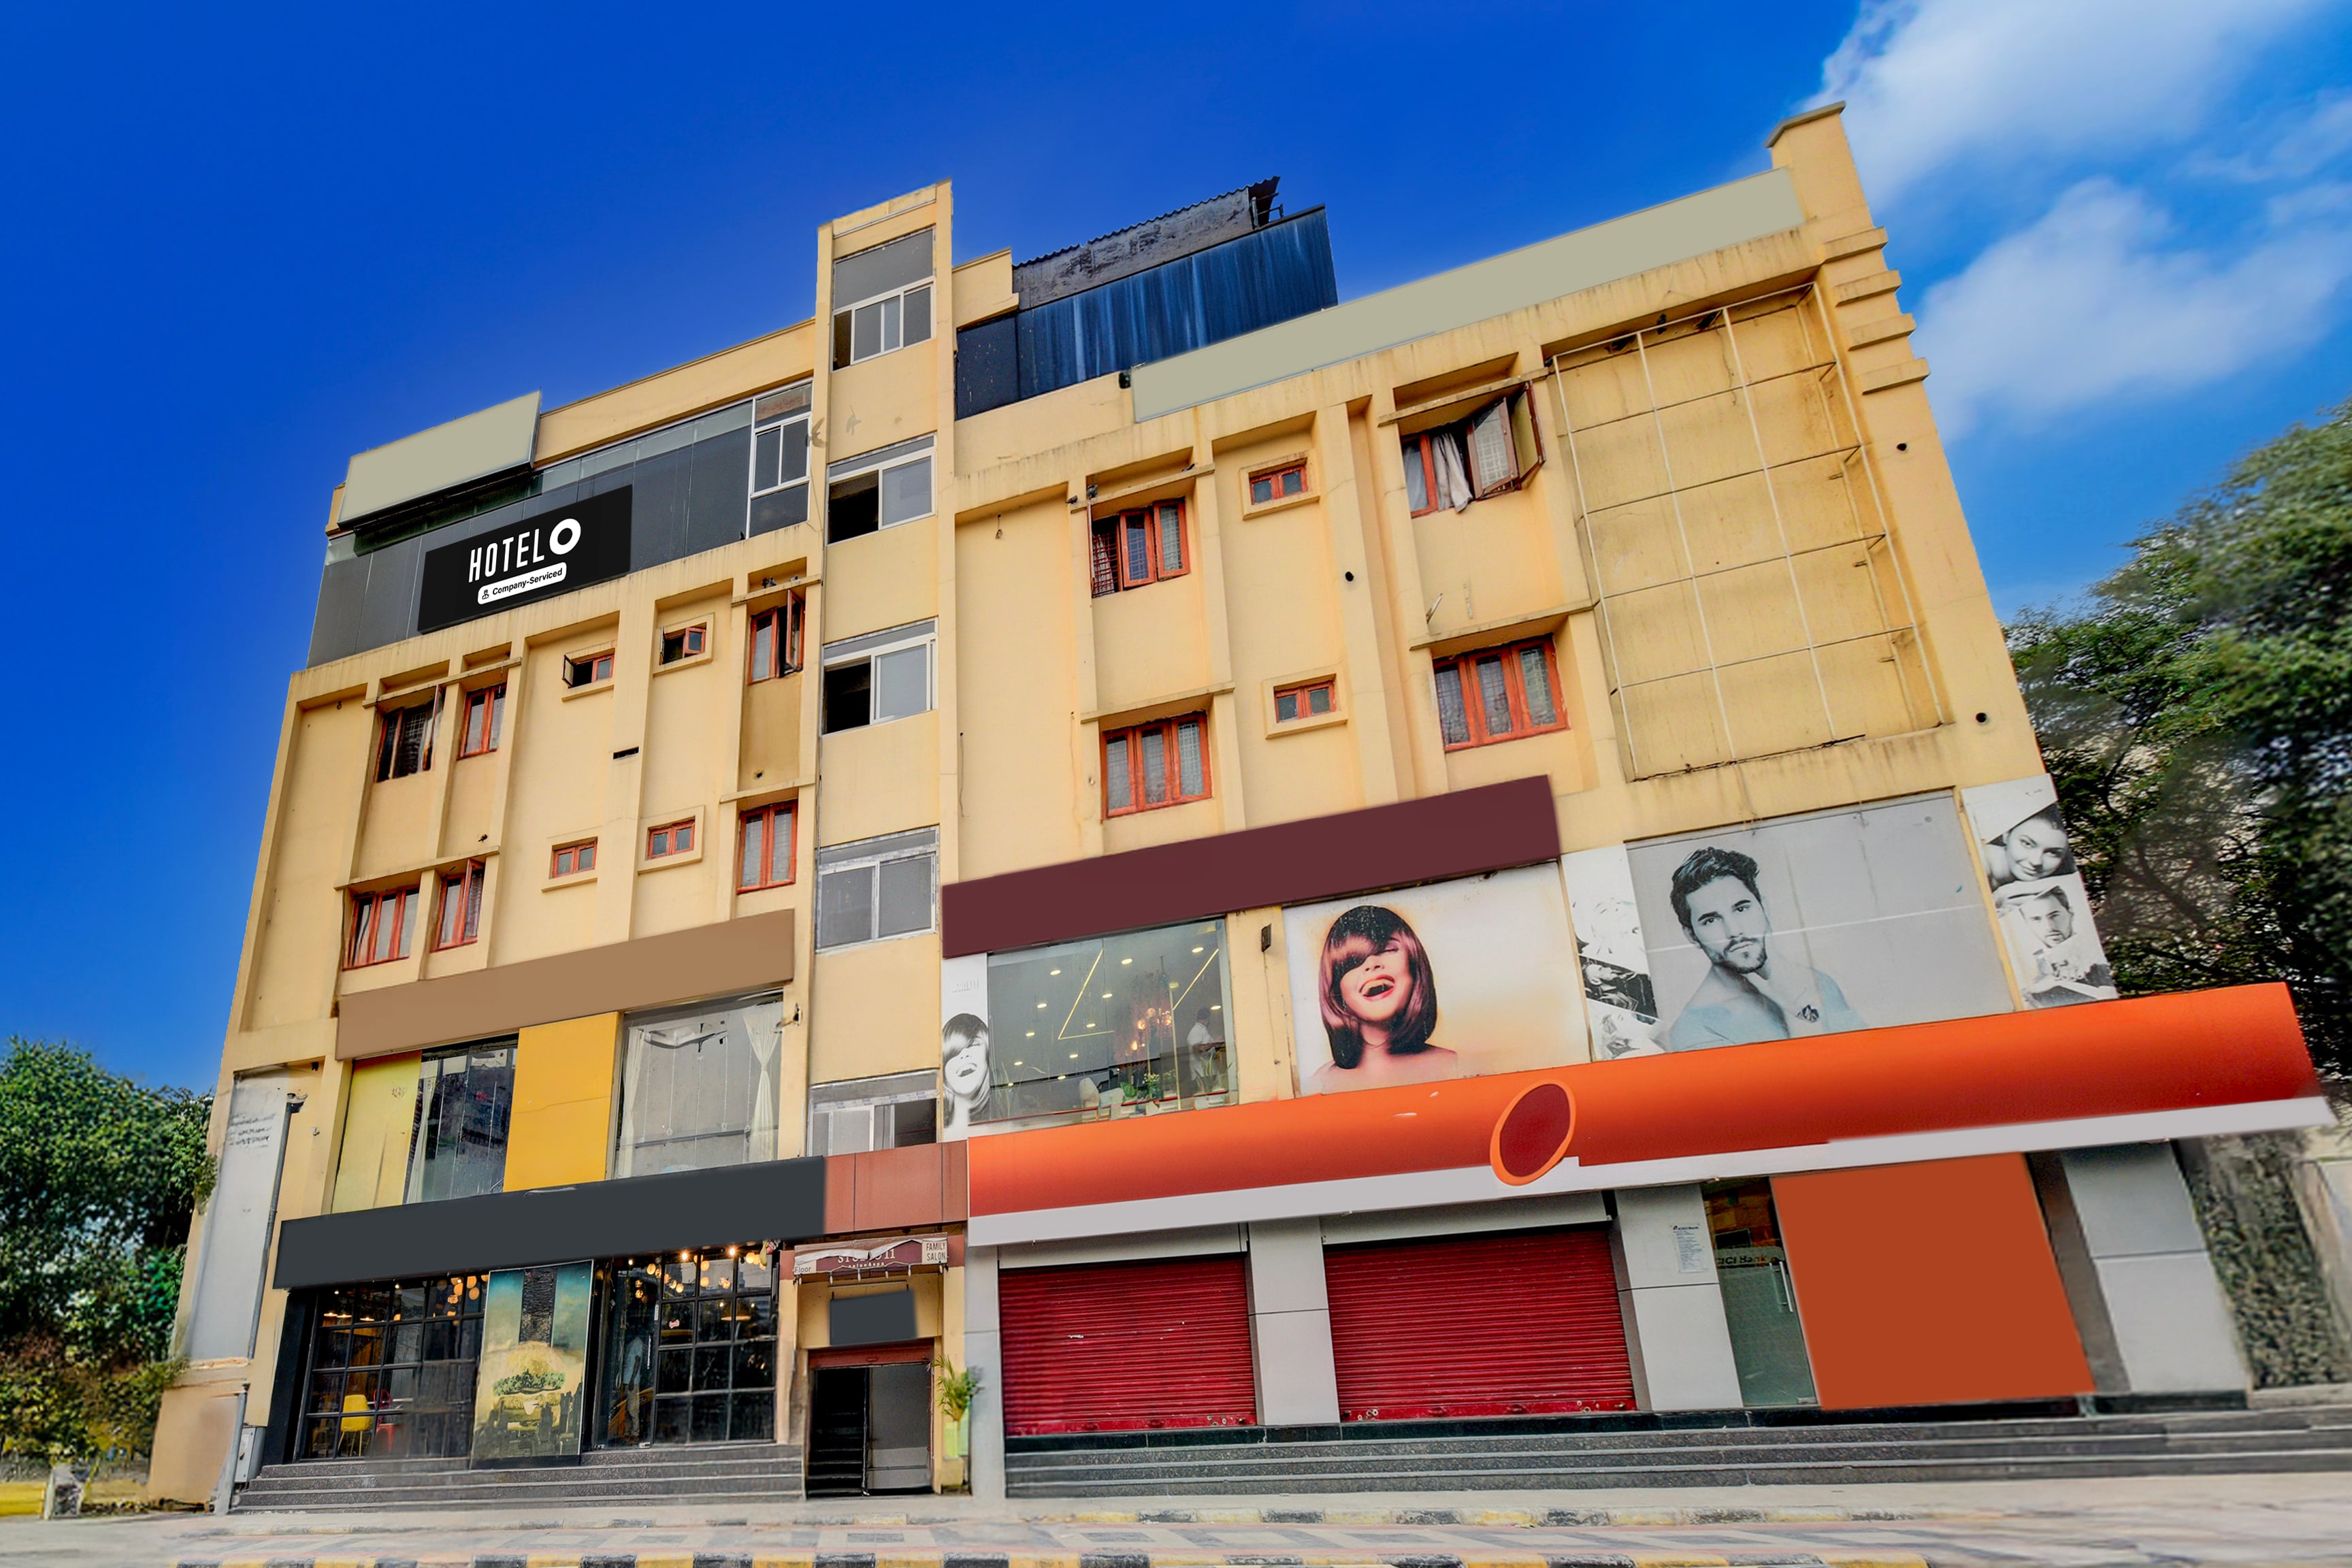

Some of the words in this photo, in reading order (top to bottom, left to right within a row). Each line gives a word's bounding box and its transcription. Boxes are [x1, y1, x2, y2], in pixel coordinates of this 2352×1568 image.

[469, 529, 544, 583] HOTEL
[492, 568, 563, 595] Company-Serviced
[926, 1242, 946, 1252] FAMILY
[927, 1252, 946, 1261] SALON
